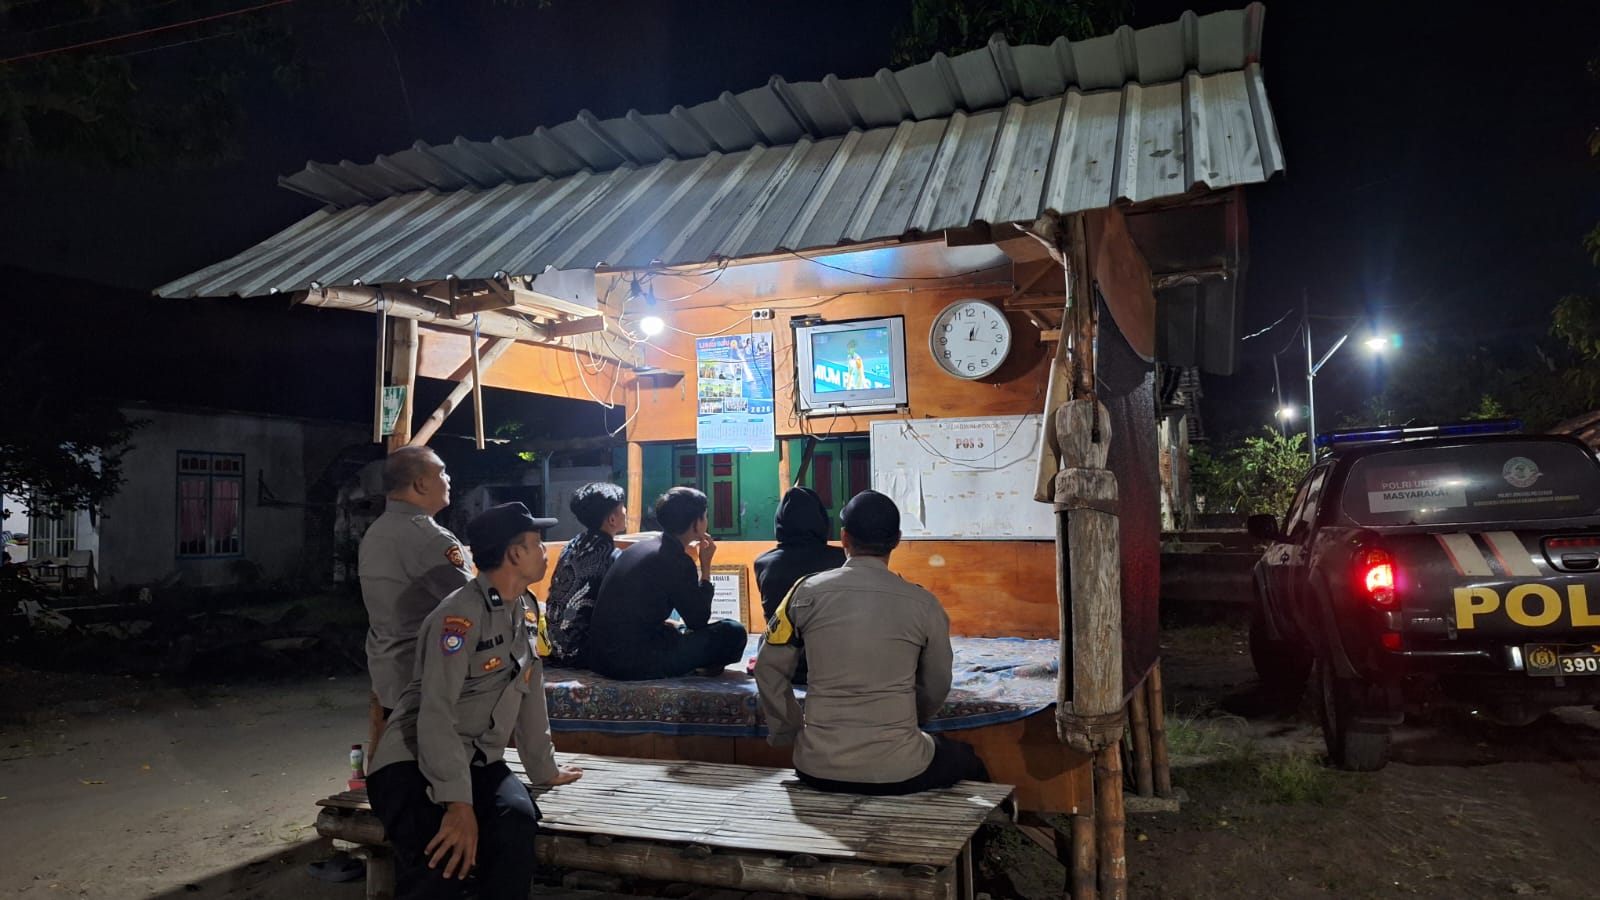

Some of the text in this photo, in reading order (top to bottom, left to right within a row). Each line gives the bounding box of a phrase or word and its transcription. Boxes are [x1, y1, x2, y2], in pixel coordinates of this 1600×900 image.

[954, 311, 961, 320] 11
[965, 308, 976, 317] 12
[942, 323, 952, 333] 10
[990, 320, 999, 330] 2
[939, 336, 948, 346] 9
[995, 333, 1003, 343] 3
[943, 350, 952, 359] 8
[990, 347, 998, 356] 4
[954, 359, 962, 368] 7
[967, 362, 976, 372] 6
[980, 358, 989, 368] 5
[955, 438, 975, 449] POS
[1382, 481, 1412, 490] POLRI
[1454, 583, 1600, 630] POL
[1562, 657, 1600, 673] 390
